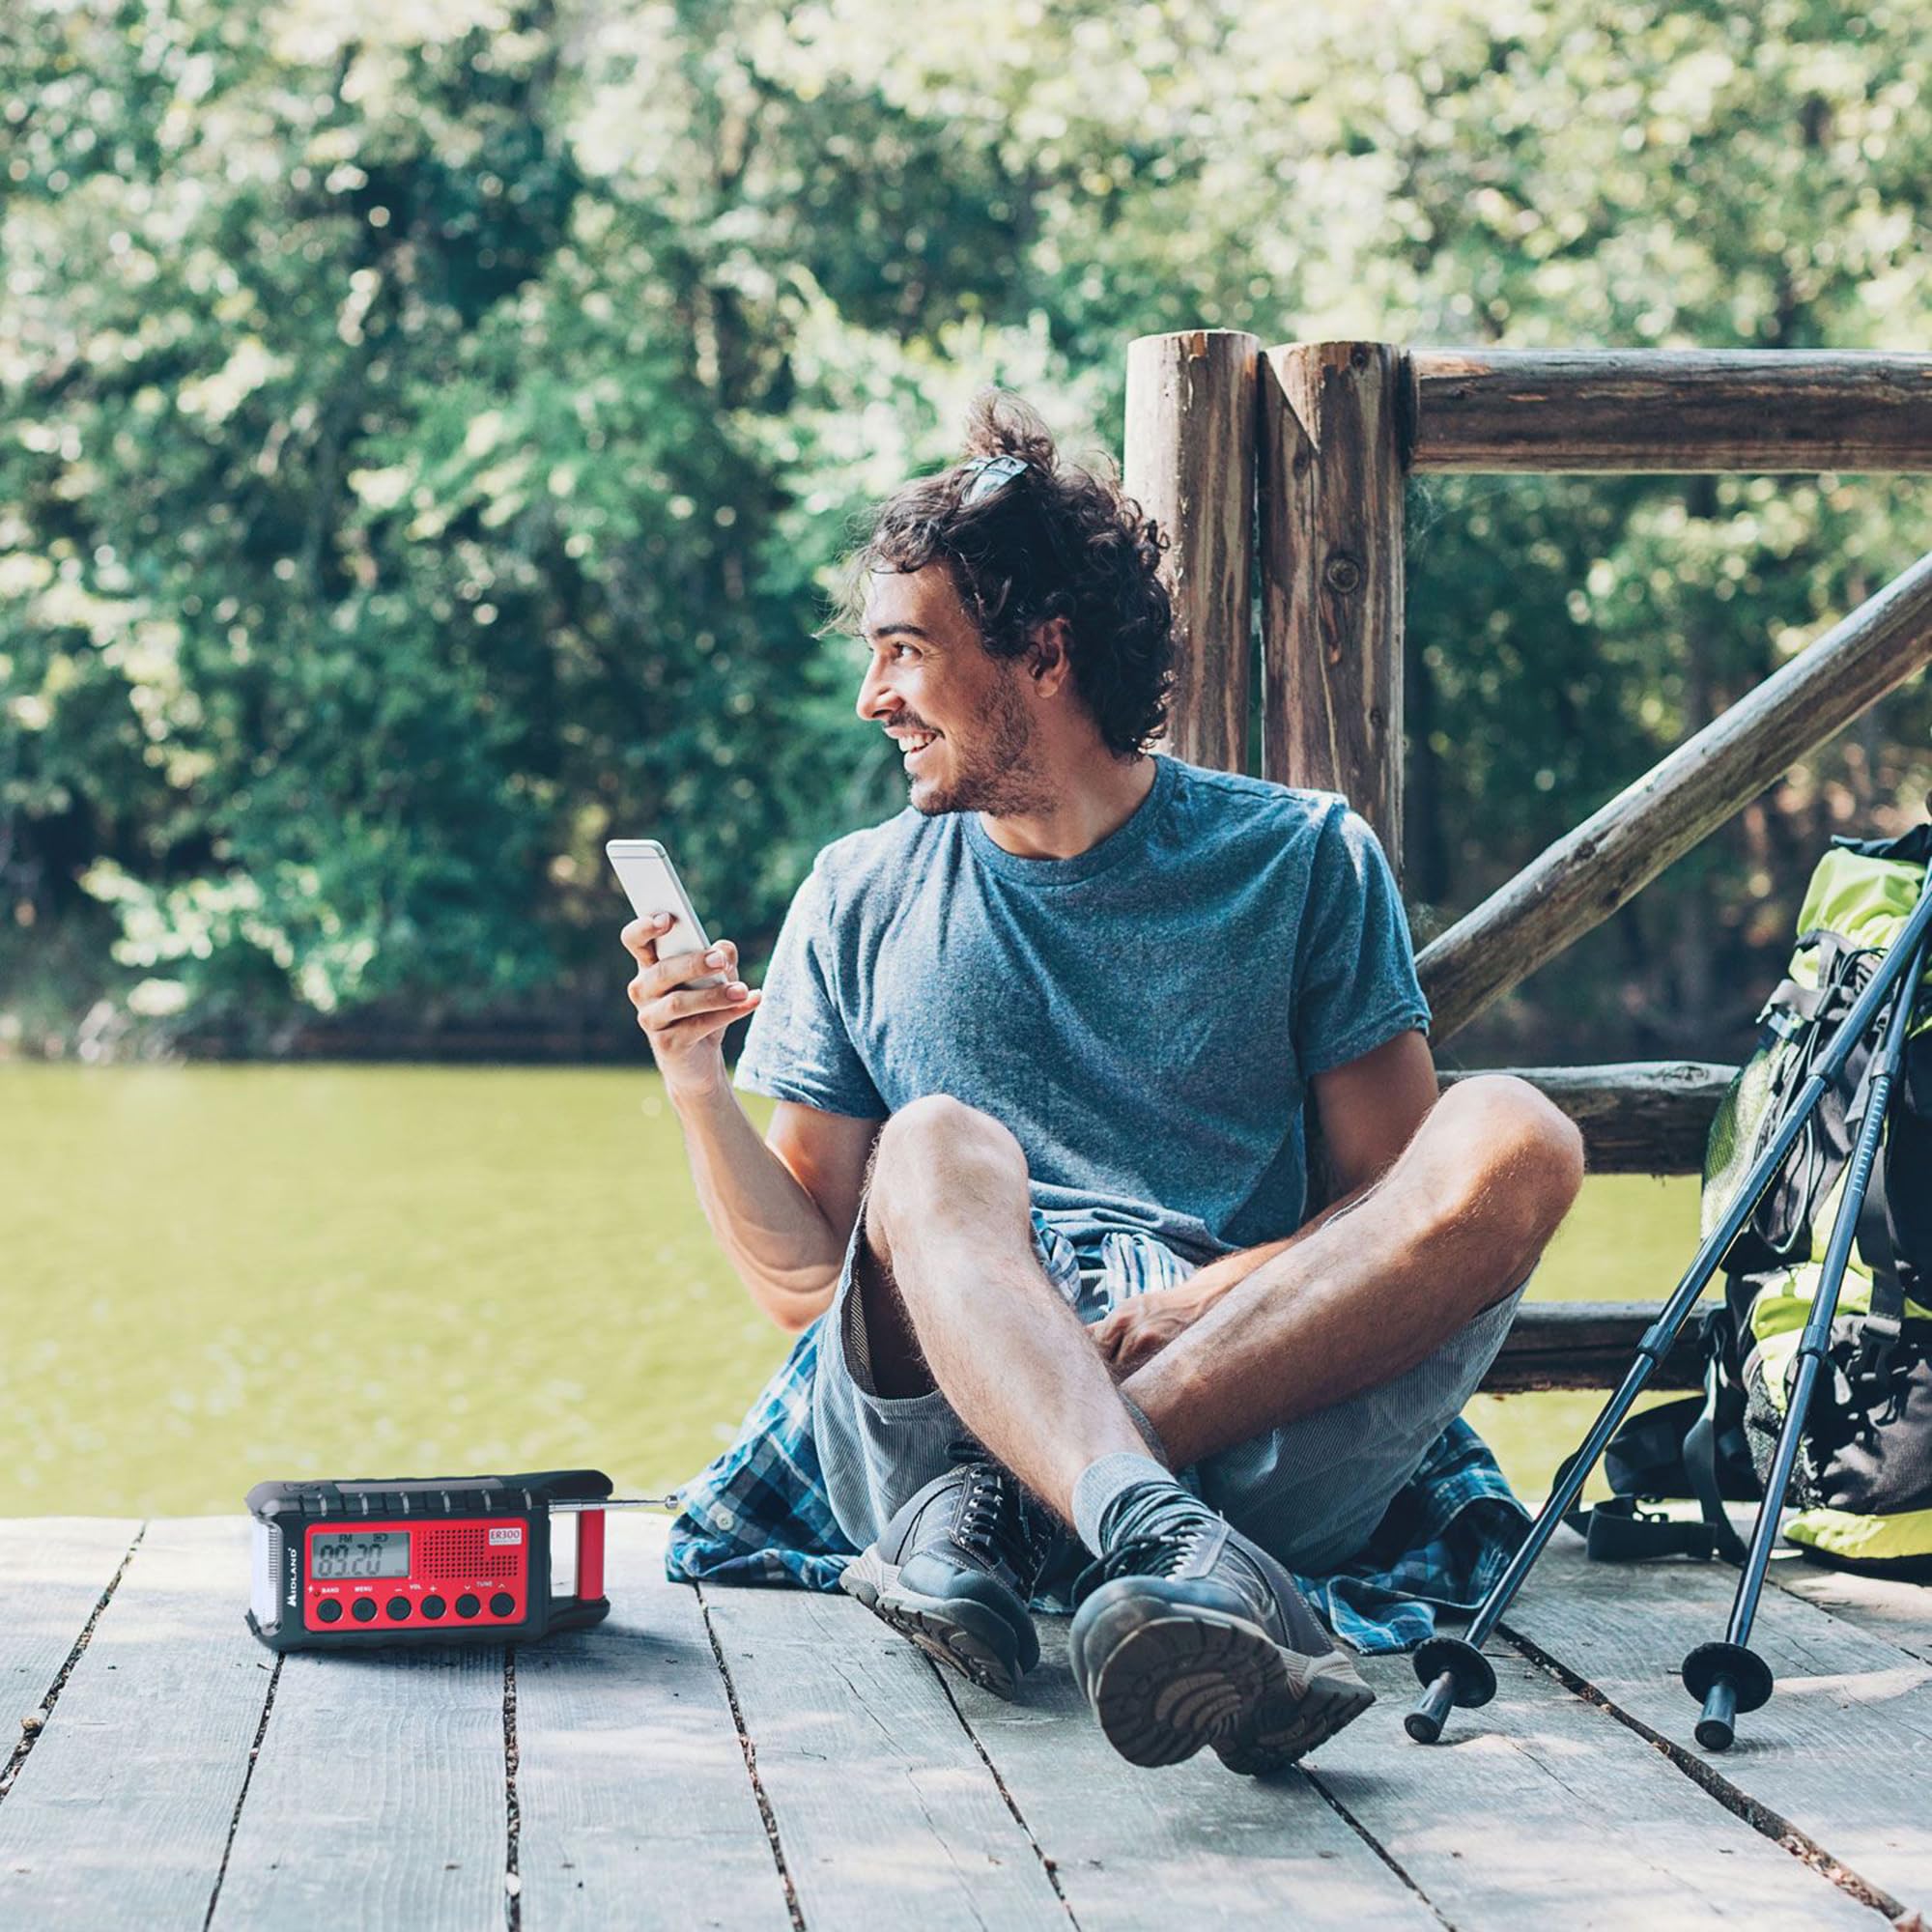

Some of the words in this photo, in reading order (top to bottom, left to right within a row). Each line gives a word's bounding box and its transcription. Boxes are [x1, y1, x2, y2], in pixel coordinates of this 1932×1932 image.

[338, 1534, 353, 1544] FM
[491, 1529, 520, 1539] ER300
[286, 1548, 298, 1607] MIDLAND
